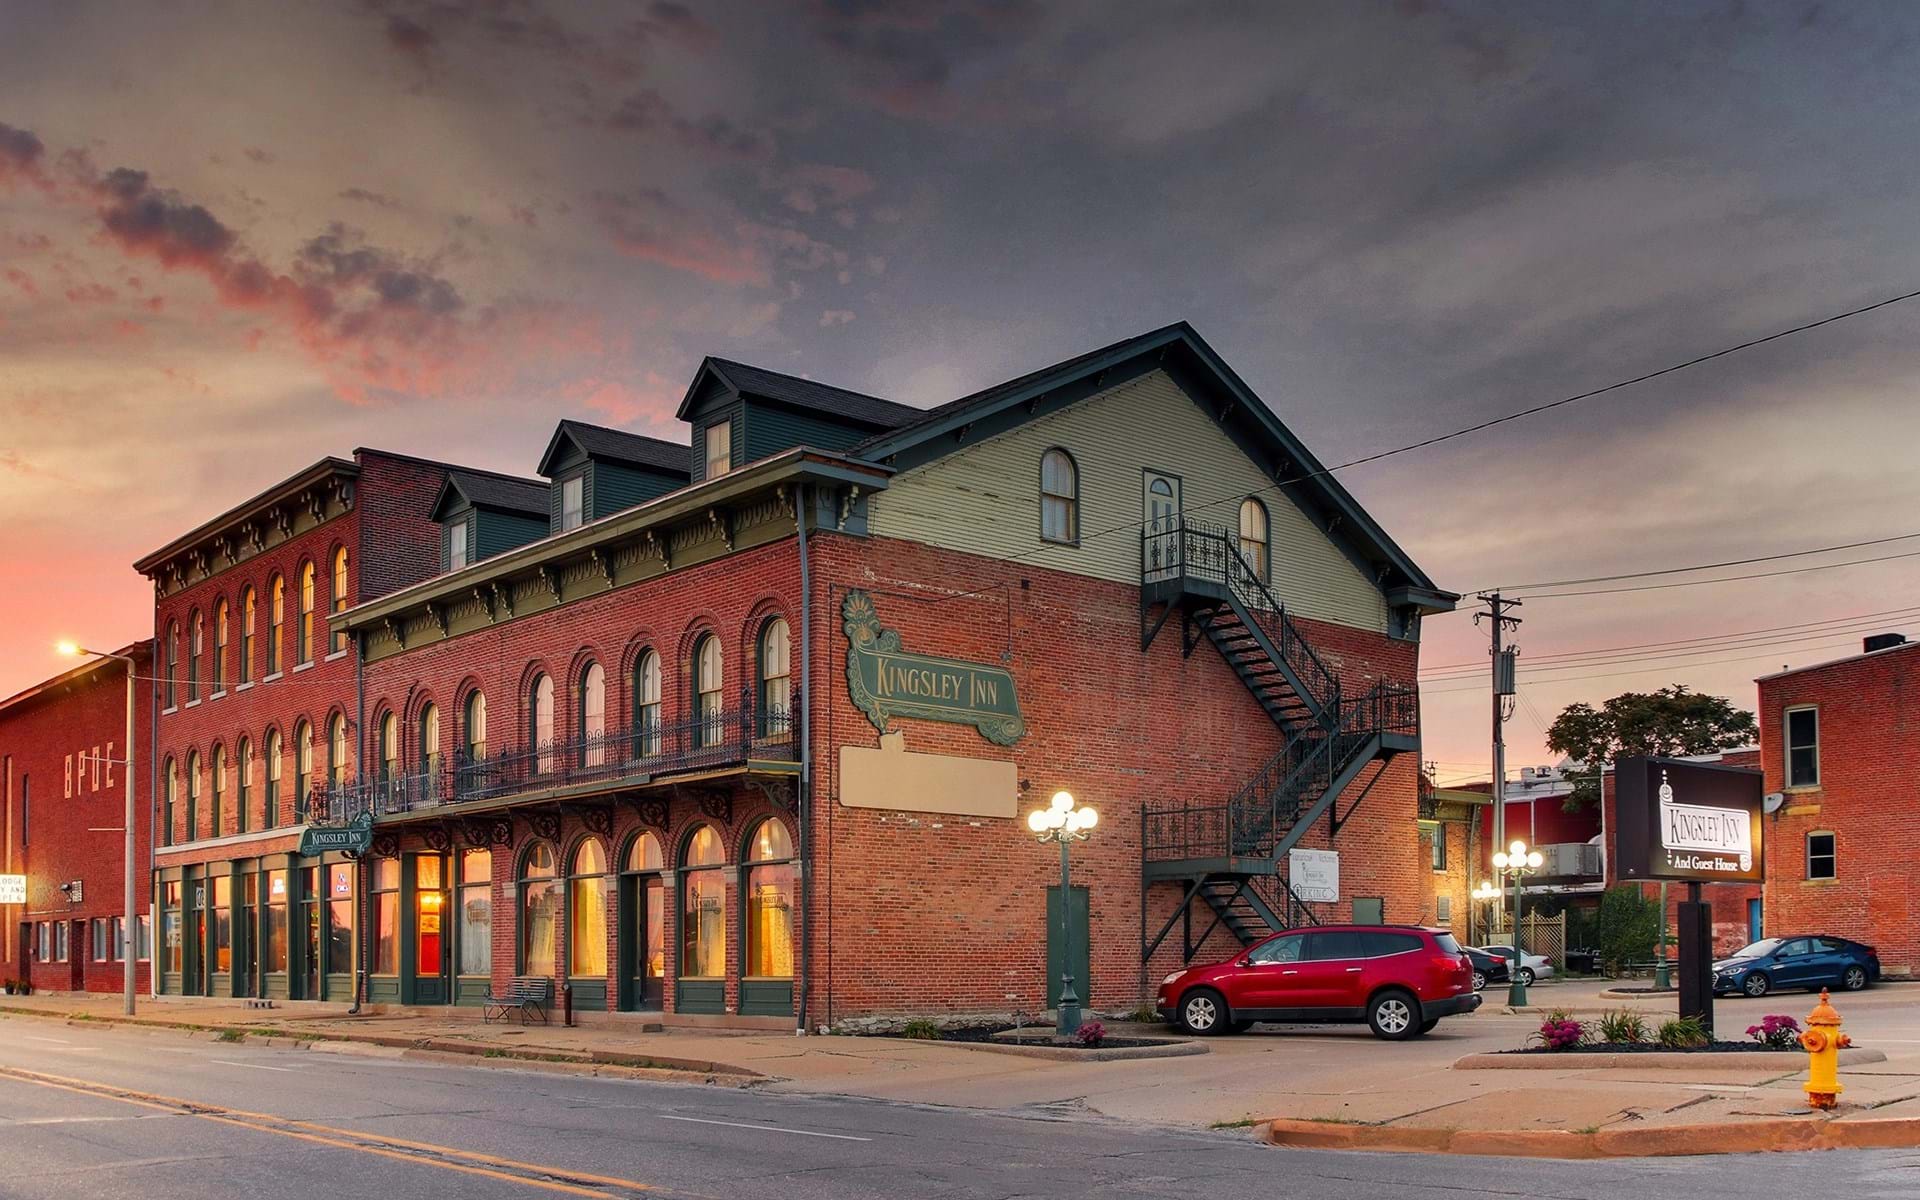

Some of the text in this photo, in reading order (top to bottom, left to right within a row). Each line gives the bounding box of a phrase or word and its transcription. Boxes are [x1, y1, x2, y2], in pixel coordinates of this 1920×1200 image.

[877, 657, 997, 707] KINGSLEY INN
[65, 741, 114, 799] BPOE
[312, 831, 361, 845] KINGSLEY INN
[1670, 809, 1740, 846] KINGSLEY INN
[1674, 855, 1738, 871] And Guest House
[0, 877, 22, 885] ODGE
